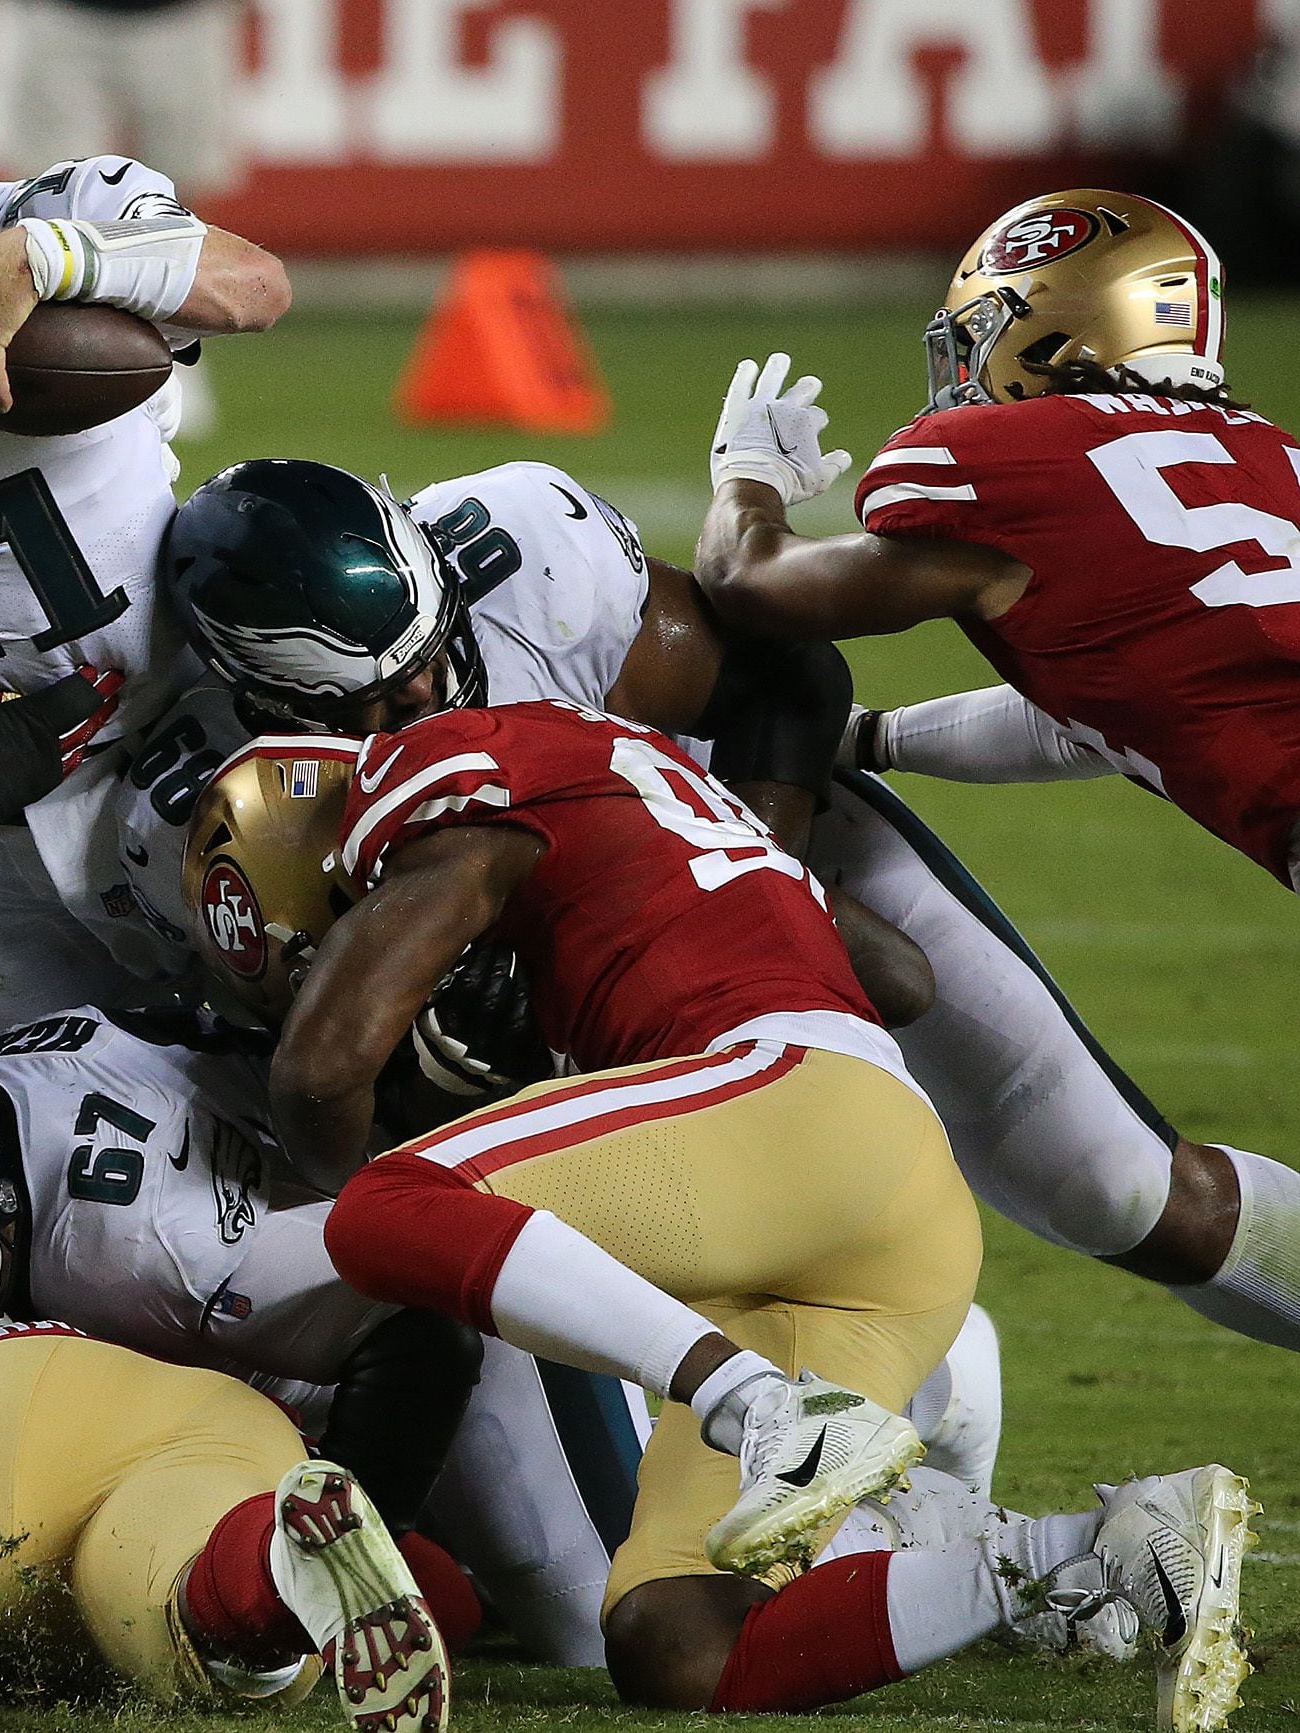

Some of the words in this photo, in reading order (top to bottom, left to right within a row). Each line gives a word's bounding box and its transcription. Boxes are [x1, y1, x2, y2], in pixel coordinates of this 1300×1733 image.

[1190, 367, 1205, 379] END
[1085, 430, 1300, 608] 5
[67, 1091, 157, 1207] 67
